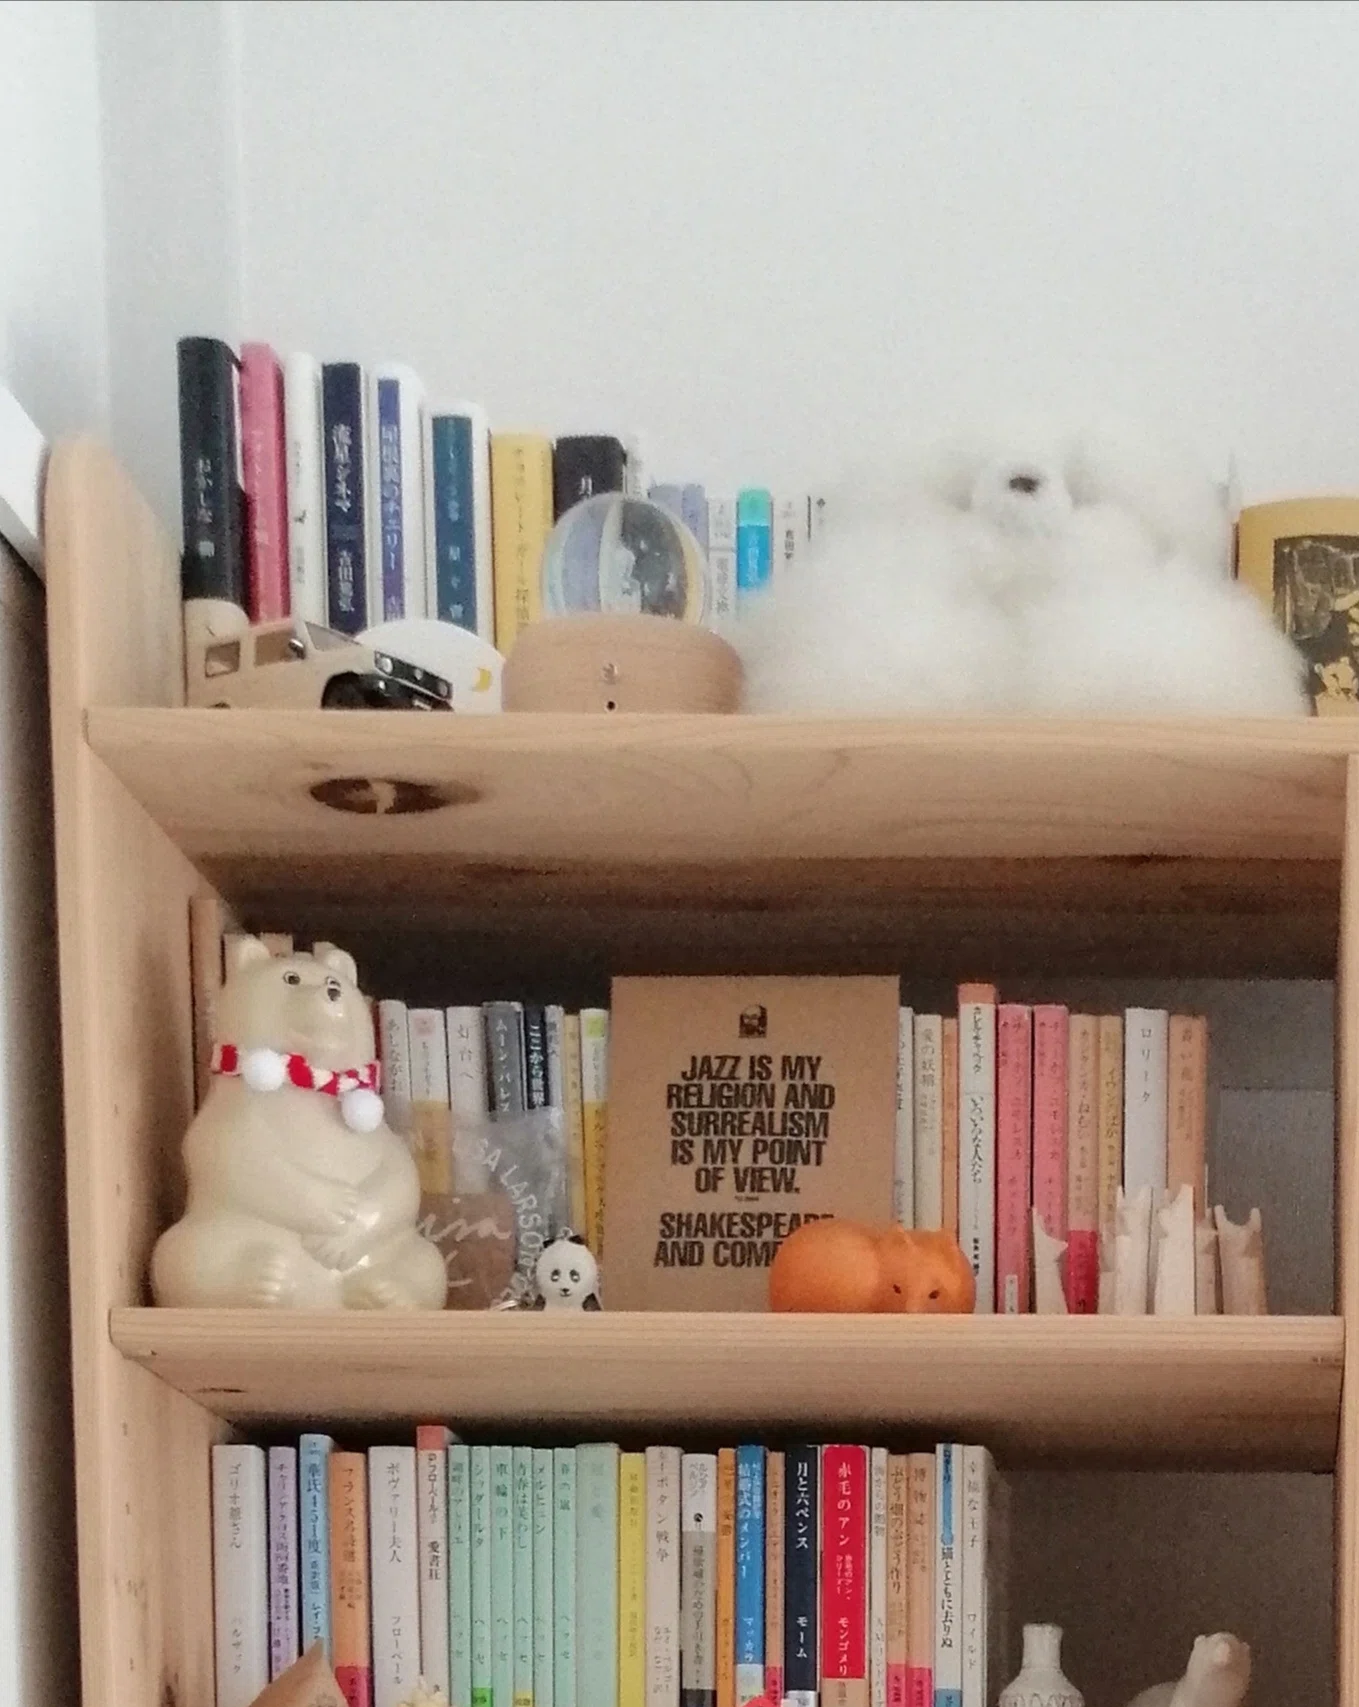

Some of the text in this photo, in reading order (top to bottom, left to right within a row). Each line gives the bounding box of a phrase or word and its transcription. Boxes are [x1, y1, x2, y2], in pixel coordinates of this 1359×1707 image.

[682, 1054, 821, 1083] JAZZ IS MY
[667, 1082, 835, 1111] RELIGION AND
[671, 1110, 829, 1138] SURREALISM
[671, 1138, 826, 1167] IS MY POINT
[696, 1166, 801, 1194] OF VIEW.
[654, 1241, 703, 1268] AND
[796, 1462, 809, 1548] 月と六ペンス
[837, 1462, 852, 1547] 赤毛のアン
